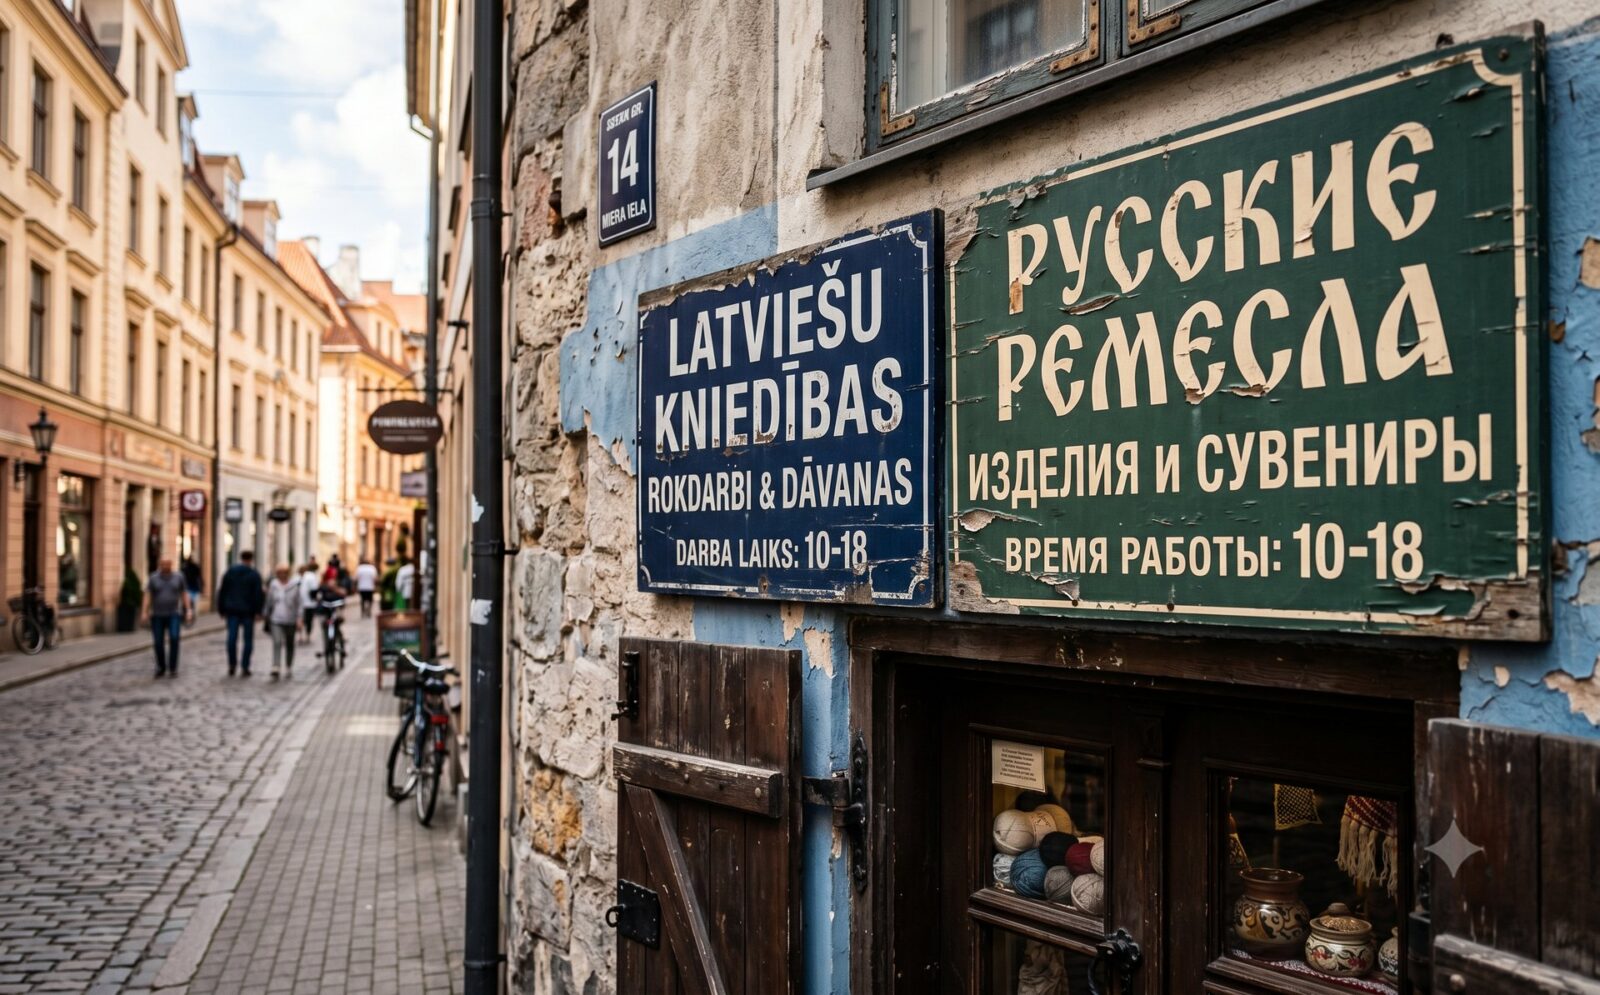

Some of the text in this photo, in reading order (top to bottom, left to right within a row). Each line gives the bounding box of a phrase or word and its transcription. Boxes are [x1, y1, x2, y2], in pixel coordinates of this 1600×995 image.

[607, 128, 639, 195] 14
[602, 198, 647, 230] MIERA IELA
[1006, 121, 1438, 316] РУССКИЕ
[669, 259, 882, 377] LATVIEŠU
[997, 262, 1453, 422] РЕМЕСЛА
[655, 357, 903, 454] KNIEDĪBAS
[648, 456, 912, 513] ROKDARBI & DĀVANAS
[968, 441, 1139, 509] ИЗДЕЛИЯ
[1196, 413, 1493, 493] СУВЕНИРЫ
[676, 530, 867, 569] DARBA LAIKS: 10-18
[1005, 521, 1424, 581] ВРЕМЯ РАБОТЫ: 10-18
